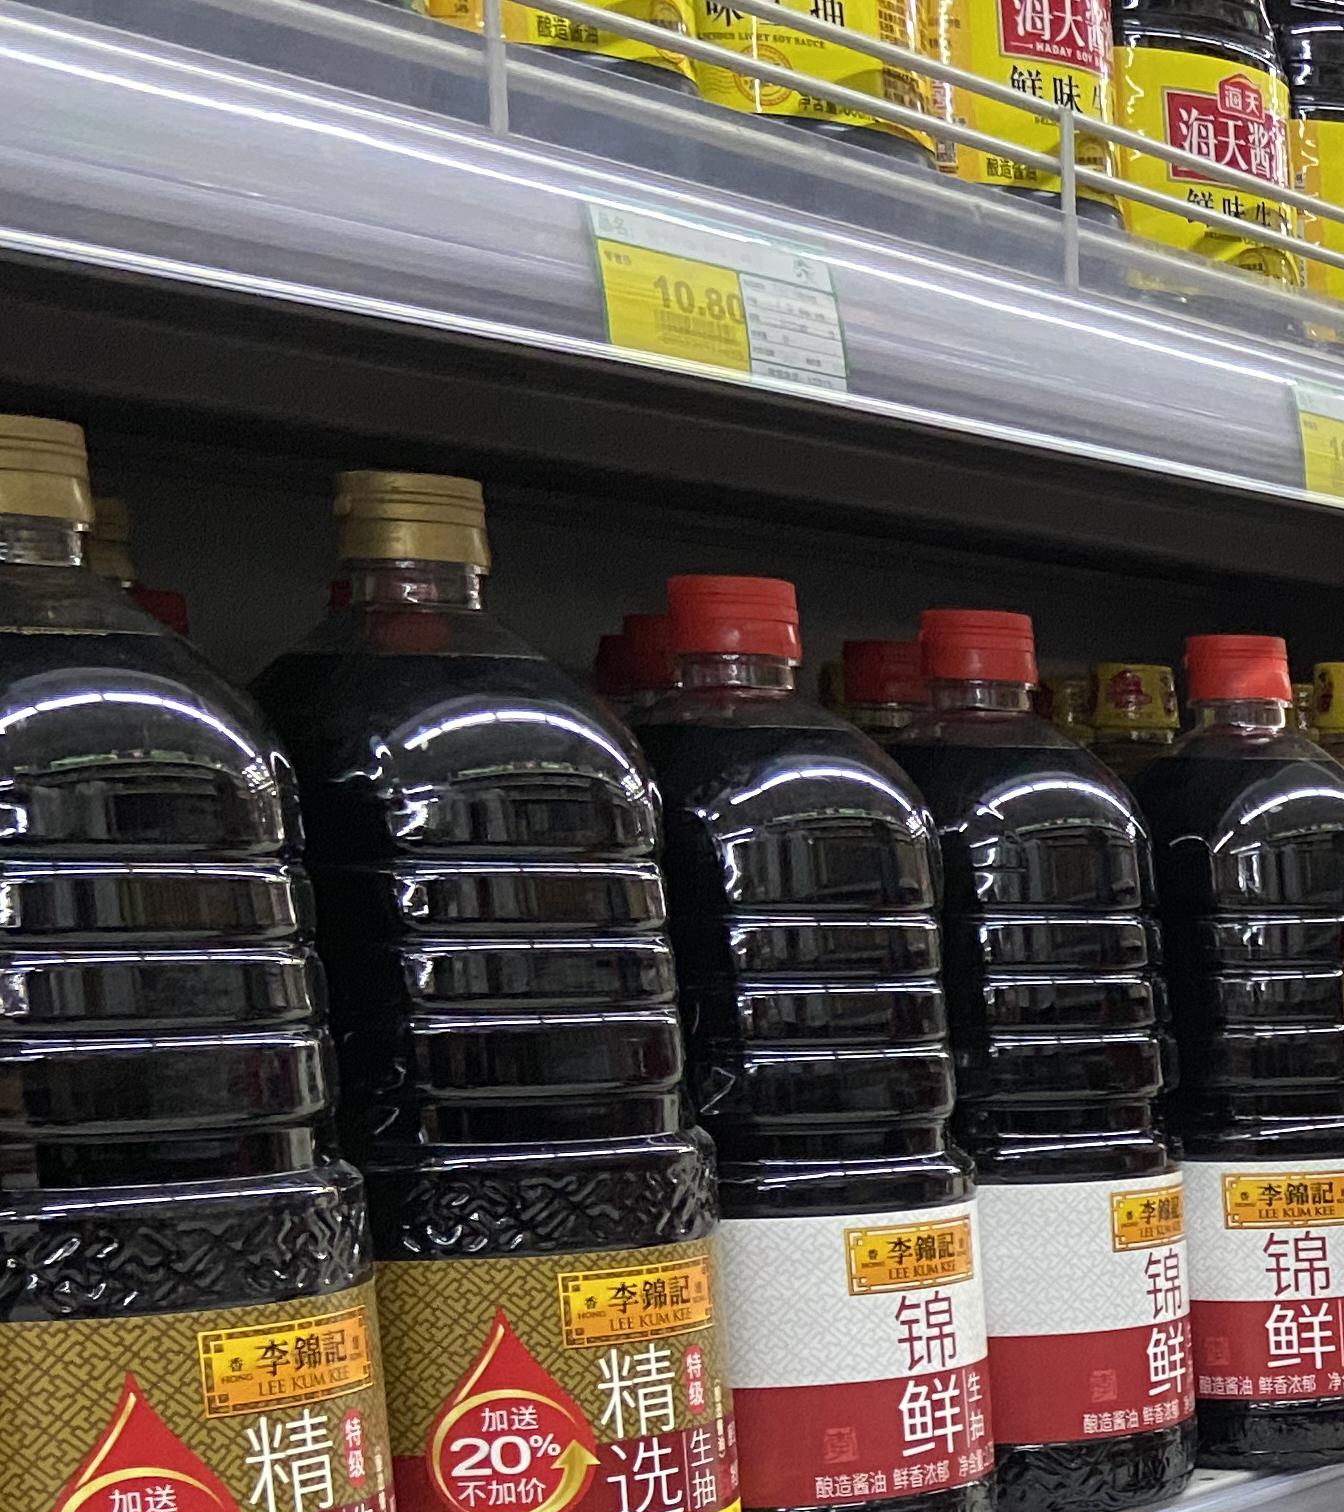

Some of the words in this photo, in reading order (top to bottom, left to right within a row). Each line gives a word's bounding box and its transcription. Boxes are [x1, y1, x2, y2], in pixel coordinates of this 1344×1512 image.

[1225, 84, 1261, 115] 海天
[652, 273, 746, 325] 10.80
[1256, 1180, 1335, 1208] 李錦記
[1258, 1206, 1279, 1220] LEE
[1282, 1205, 1312, 1219] KUM
[1314, 1205, 1337, 1218] KEE
[886, 1230, 956, 1265] 李錦記
[888, 1264, 911, 1282] LEE
[913, 1262, 939, 1278] KUM
[607, 1274, 692, 1316] 李錦記
[1262, 1230, 1337, 1371] 锦鲜
[609, 1316, 634, 1333] LEE
[638, 1311, 669, 1328] KUM
[672, 1305, 694, 1322] KEE
[1144, 1247, 1187, 1397] 锦鲜
[255, 1328, 348, 1377] 李錦記
[894, 1288, 964, 1459] 锦鲜
[257, 1378, 288, 1398] LEE
[291, 1372, 326, 1393] KUM
[326, 1368, 350, 1386] KEE
[684, 1354, 705, 1407] 特级
[1198, 1374, 1254, 1397] 酿造酱油
[1258, 1373, 1318, 1395] 鲜香浓郁
[480, 1406, 540, 1433] 加送
[966, 1370, 985, 1442] 生抽
[1082, 1407, 1140, 1434] 酿造酱油
[345, 1416, 368, 1480] 特级
[449, 1432, 562, 1479] 20%
[688, 1429, 719, 1511] 生抽
[814, 1468, 888, 1500] 酿造酱油
[892, 1458, 951, 1491] 鲜香浓郁
[456, 1477, 547, 1509] 不加价
